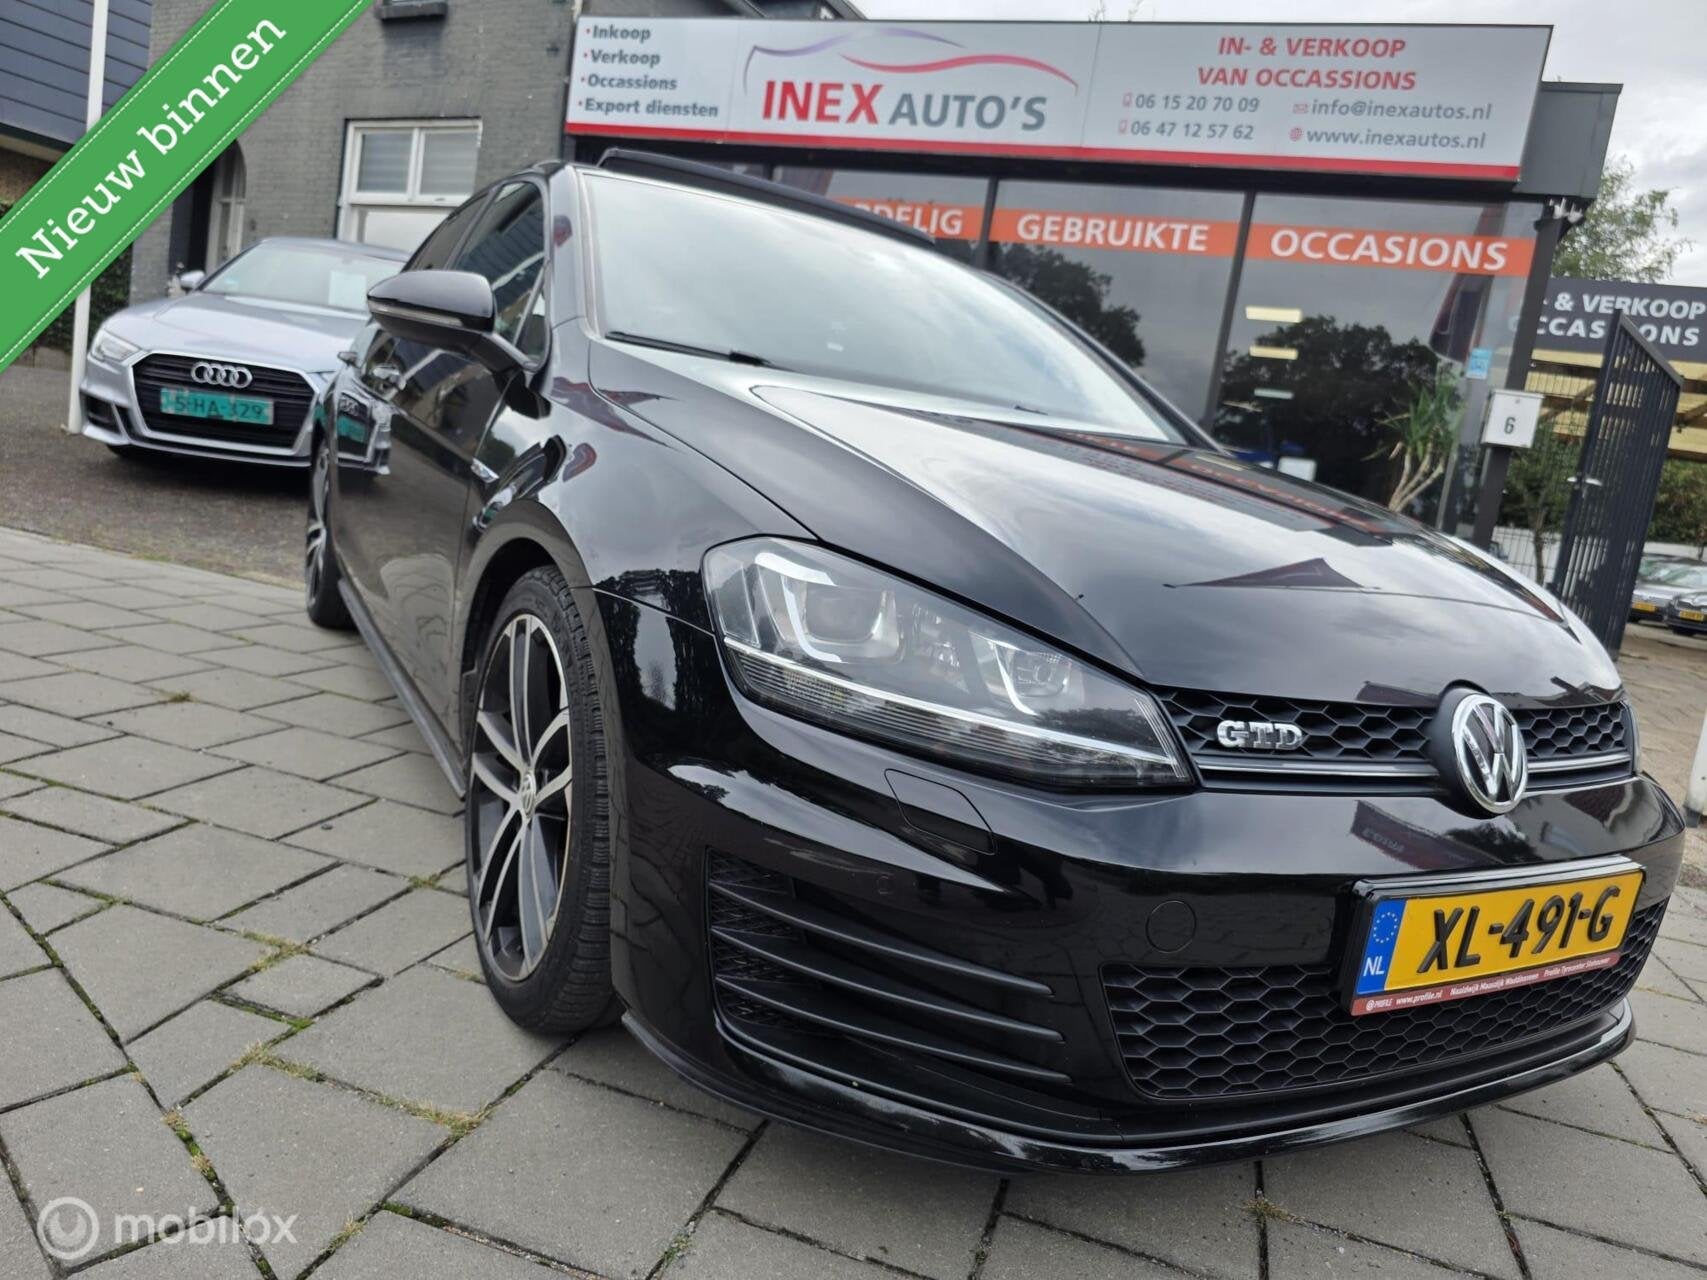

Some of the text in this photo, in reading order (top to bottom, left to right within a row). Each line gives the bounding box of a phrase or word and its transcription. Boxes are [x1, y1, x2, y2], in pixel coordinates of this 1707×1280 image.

[592, 24, 651, 44] Inkoop
[1218, 37, 1406, 58] IN- & VERKOOP
[591, 49, 661, 69] Verkoop
[587, 73, 678, 91] Occassions
[1198, 67, 1417, 90] VAN OCCASSIONS
[584, 98, 719, 118] Export diensten
[762, 80, 1047, 131] INEX AUTO'S
[1136, 94, 1260, 113] 06 15 20 70 09
[1310, 99, 1493, 121] info@inexautos.nl
[1131, 120, 1254, 140] 06 47 12 57 62
[1307, 127, 1487, 149] www.inexautos.nl
[855, 203, 1508, 271] ELIG GEBRUIKTE OCCASIONS
[1554, 292, 1706, 320] & VERKOOP
[1503, 416, 1516, 434] 6
[1216, 719, 1303, 751] GTD
[1416, 885, 1621, 974] XL-491-G
[1363, 956, 1385, 977] NL
